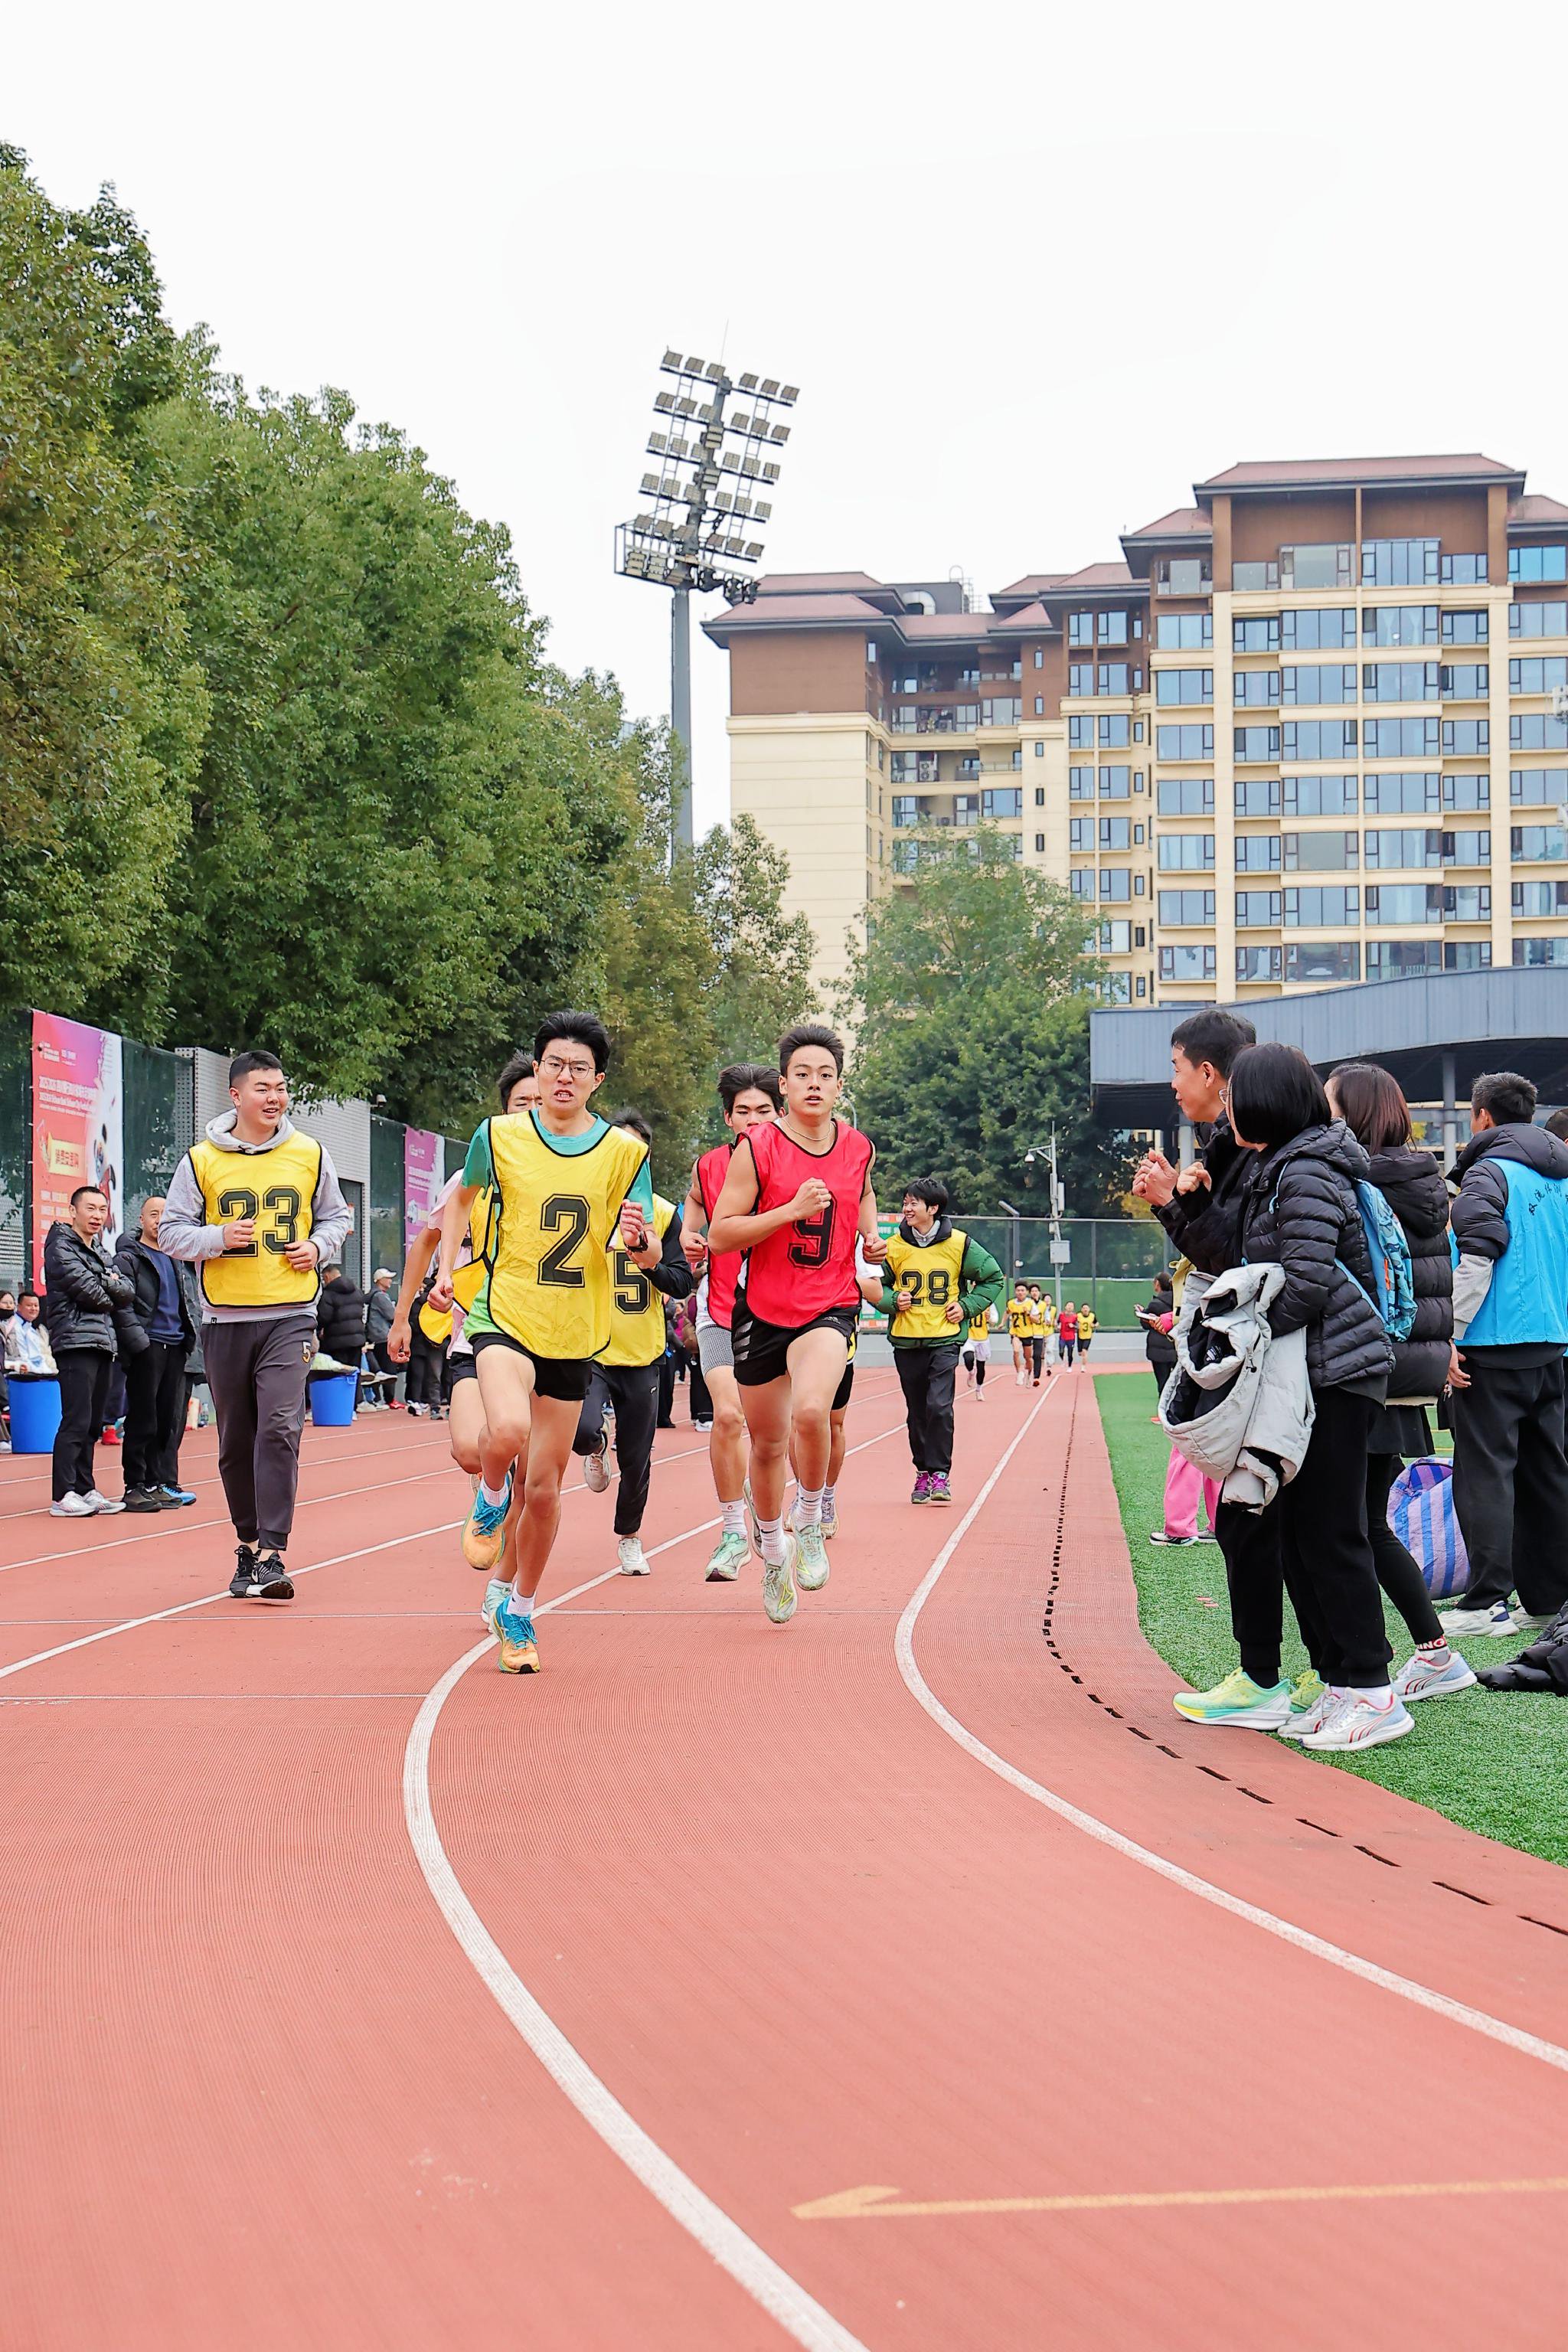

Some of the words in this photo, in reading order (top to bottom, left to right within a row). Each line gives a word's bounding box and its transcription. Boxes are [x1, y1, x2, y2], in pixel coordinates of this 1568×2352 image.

[217, 1185, 302, 1258] 23
[537, 1194, 591, 1289] 2
[787, 1190, 837, 1270] 9
[614, 1250, 651, 1315] 5
[900, 1269, 950, 1307] 28
[302, 1341, 312, 1364] 5
[1082, 1322, 1089, 1332] 3
